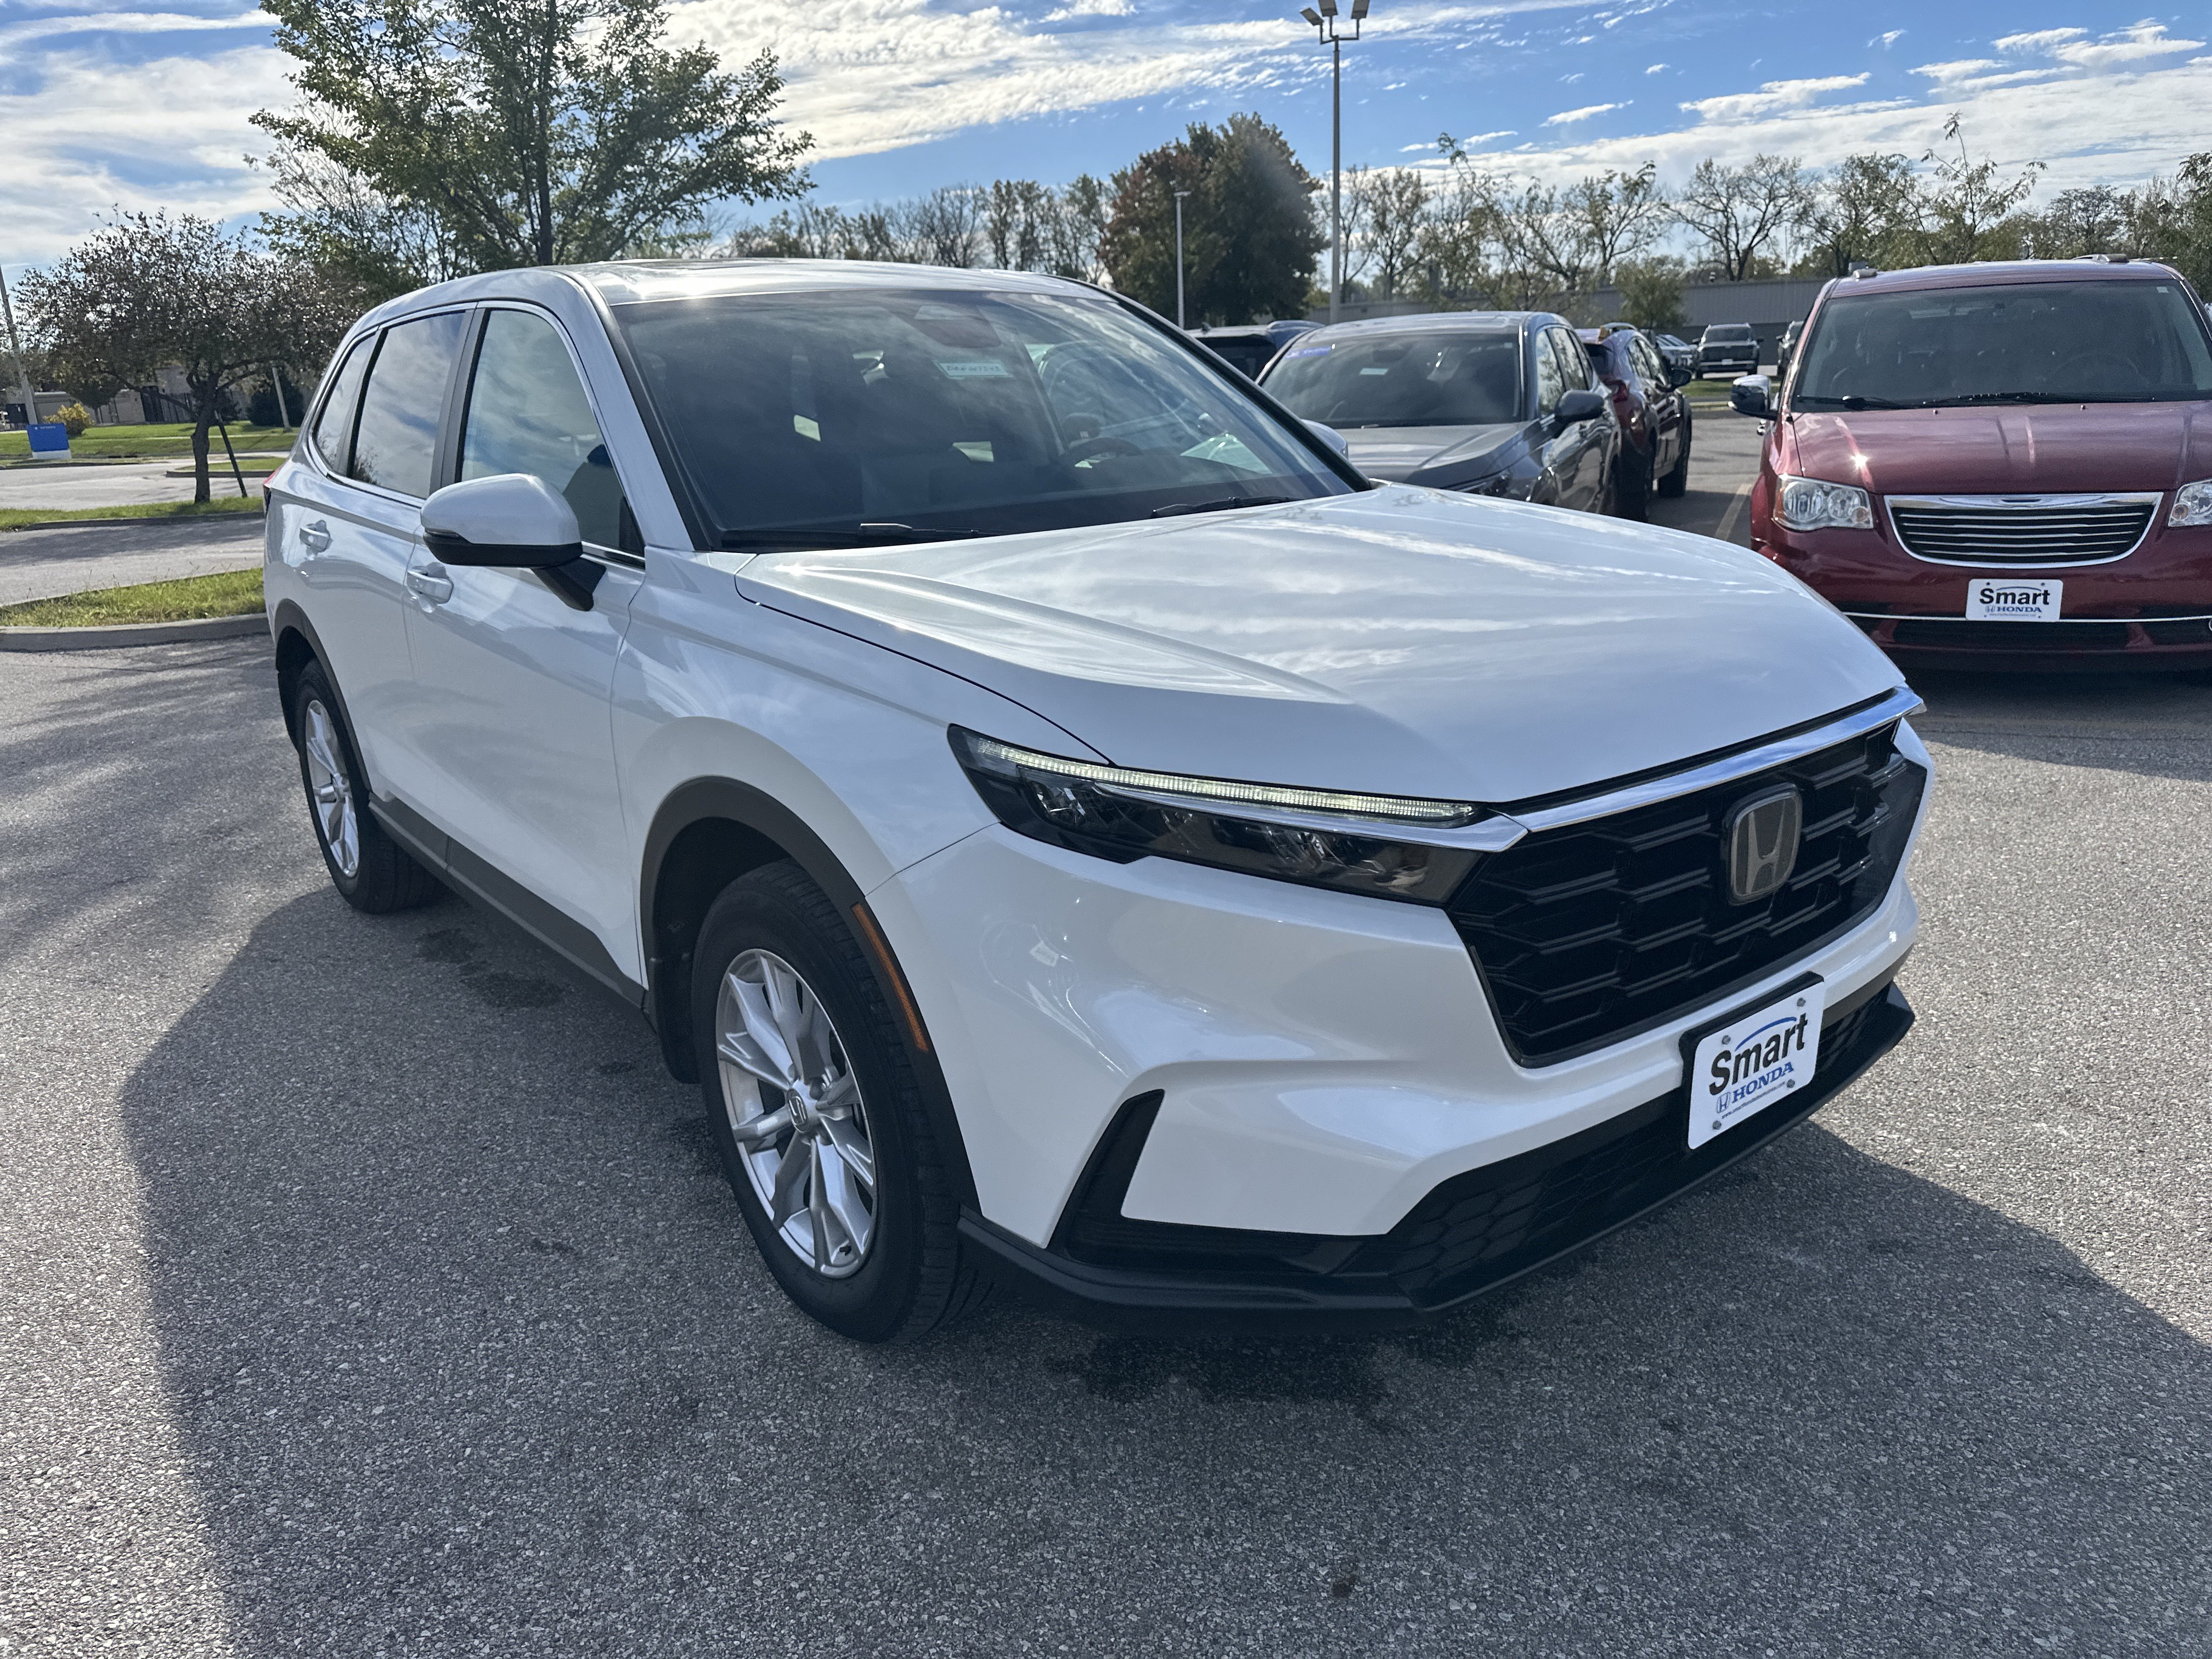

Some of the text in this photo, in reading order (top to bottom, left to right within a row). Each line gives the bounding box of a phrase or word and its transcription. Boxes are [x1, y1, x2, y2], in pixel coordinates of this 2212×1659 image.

[1980, 588, 2050, 605] Smart
[1709, 1013, 1808, 1095] Smart
[1732, 1062, 1794, 1103] HONDA
